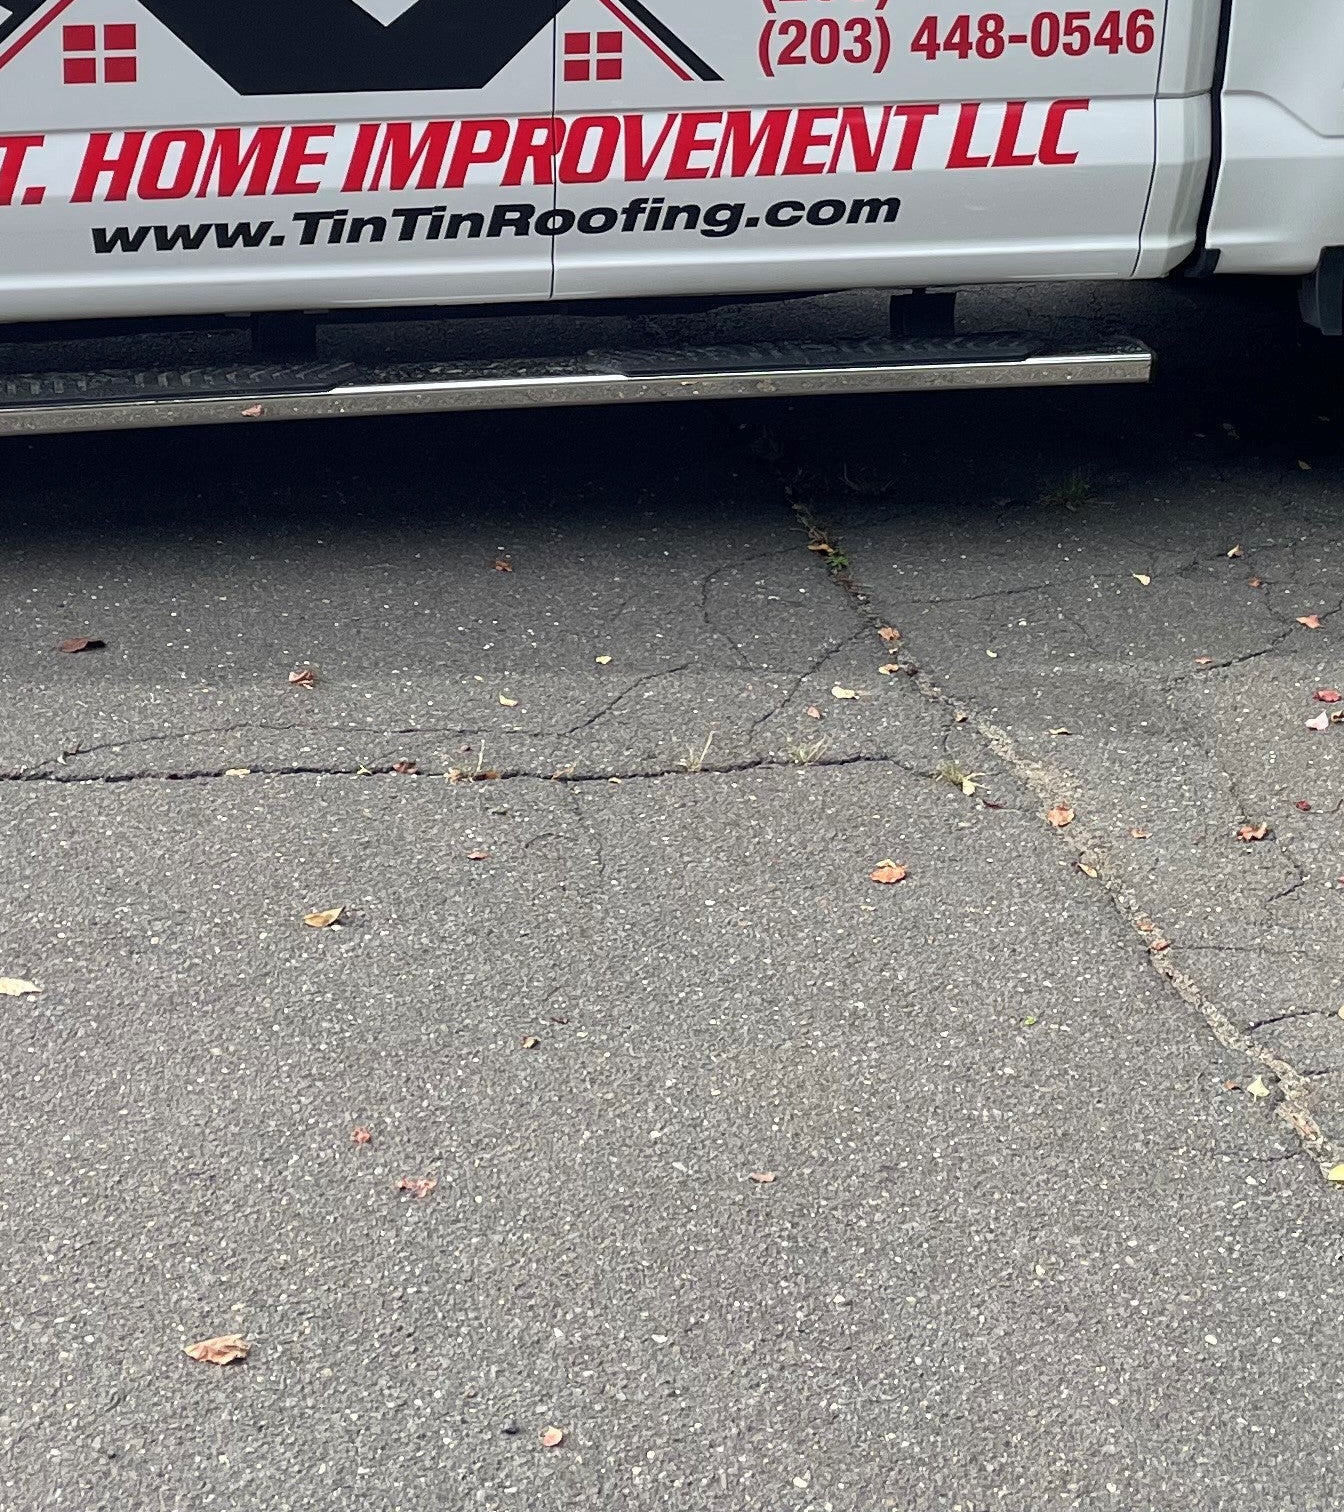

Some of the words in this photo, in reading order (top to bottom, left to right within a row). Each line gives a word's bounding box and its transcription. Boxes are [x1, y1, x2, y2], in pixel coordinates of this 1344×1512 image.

[758, 16, 891, 77] (203)
[911, 8, 1155, 60] 448-0546
[71, 124, 335, 203] HOME
[341, 103, 939, 193] IMPROVEMENT
[946, 99, 1089, 169] LLC
[92, 196, 901, 254] www.TinTinRoofing.com
